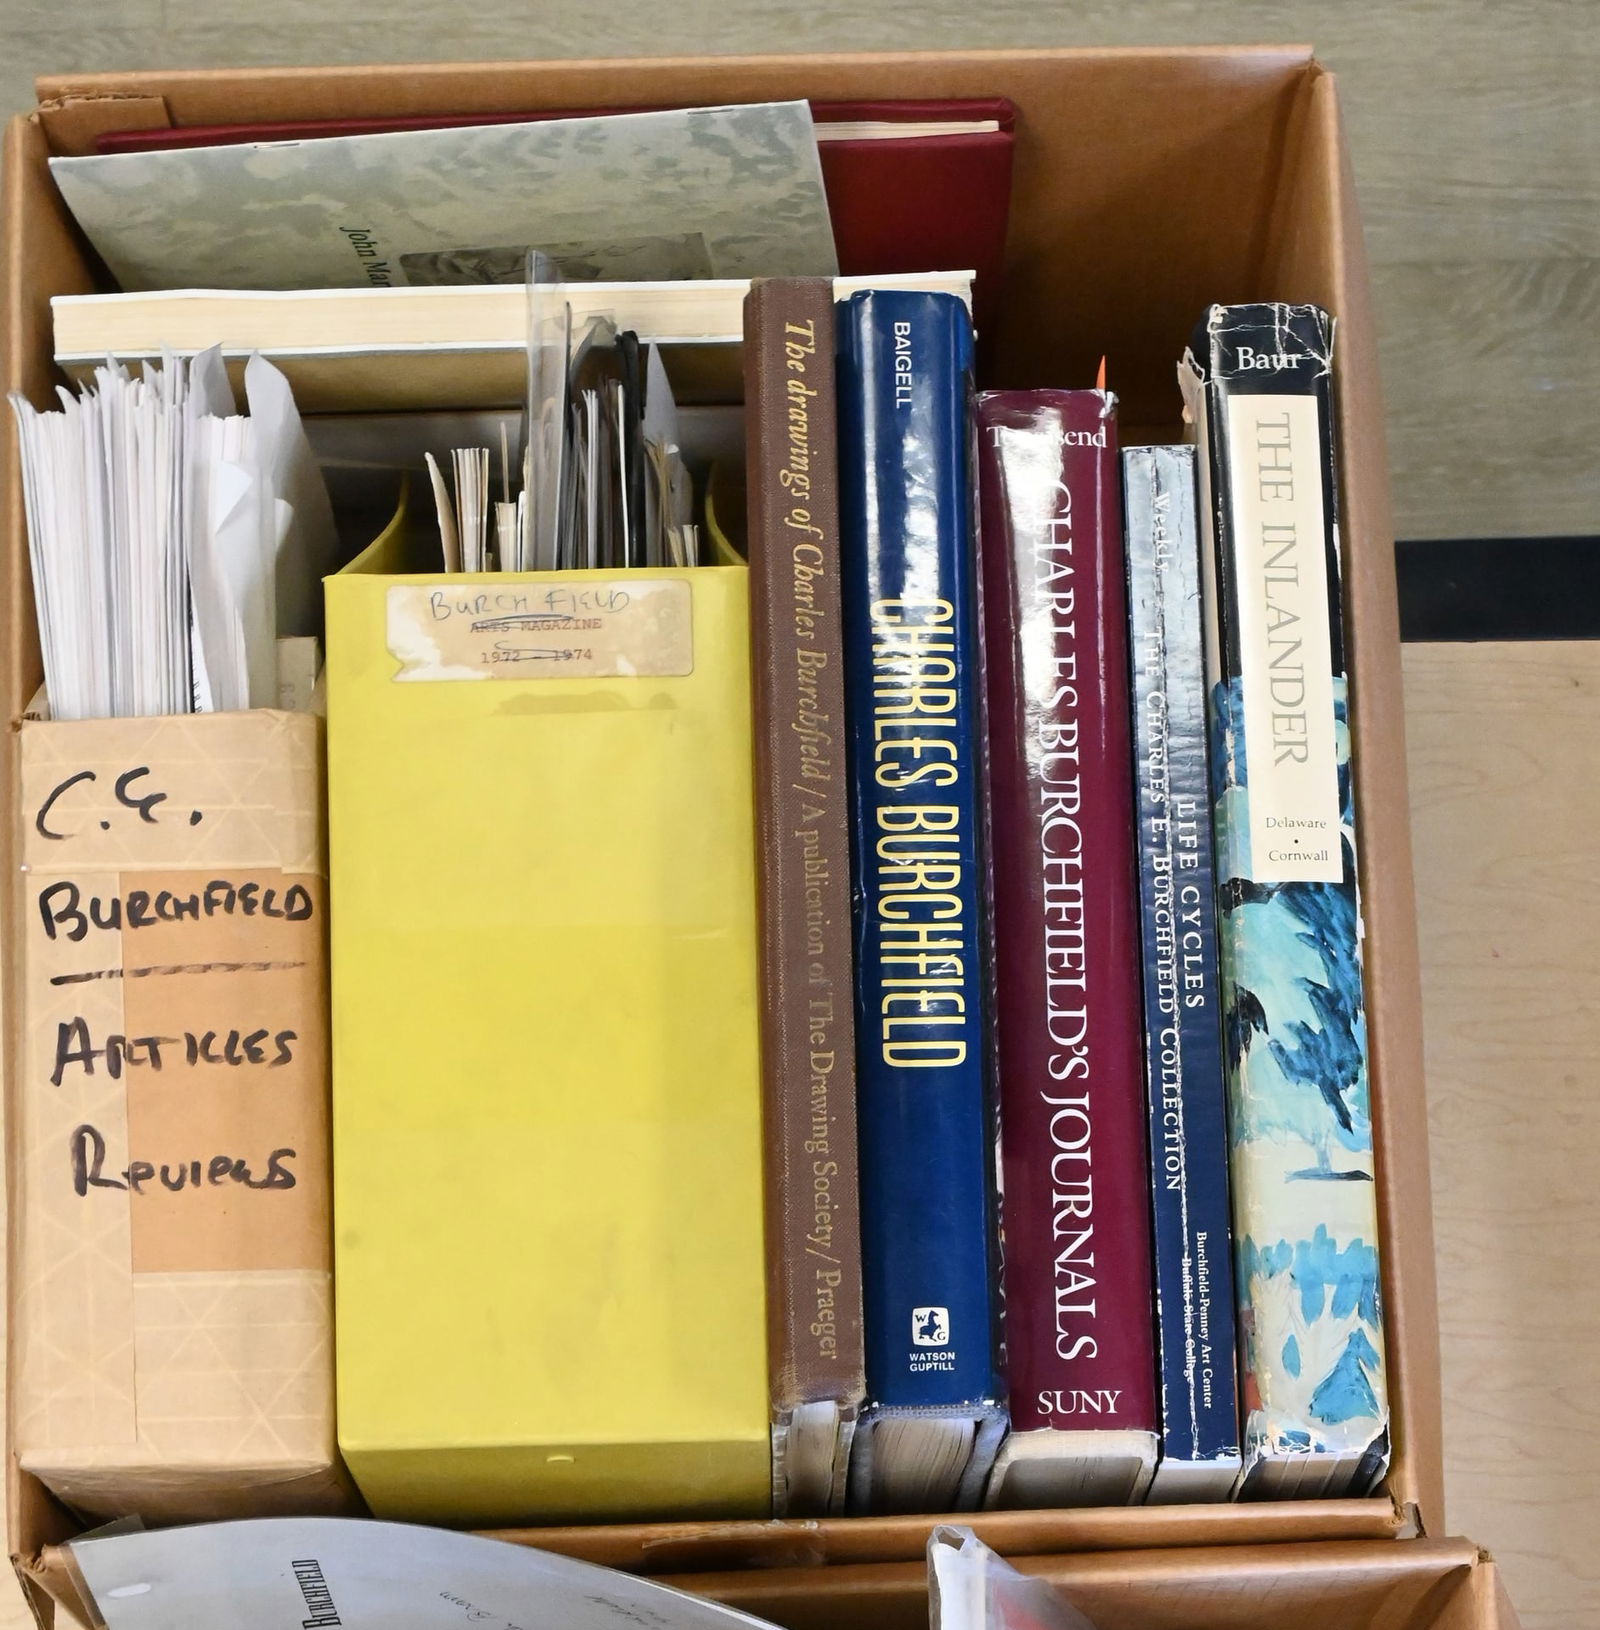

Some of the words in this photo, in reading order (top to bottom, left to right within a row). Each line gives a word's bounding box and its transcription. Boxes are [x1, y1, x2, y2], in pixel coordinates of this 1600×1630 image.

[339, 226, 378, 258] John
[785, 320, 816, 373] The
[893, 321, 912, 409] BAIGELL
[1235, 346, 1301, 370] Baur
[779, 378, 813, 503] drawings
[1255, 412, 1294, 504] THE
[784, 508, 825, 540] of
[791, 545, 825, 637] Charles
[1032, 481, 1078, 709] CHARLES
[1144, 624, 1162, 674] THE
[1261, 522, 1309, 768] INLANDER
[791, 649, 832, 780] Burchfield
[869, 598, 959, 788] CHARLES
[1144, 691, 1166, 804] CHARLES
[1176, 800, 1197, 869] LIFE
[1265, 816, 1327, 831] Delaware
[1268, 849, 1329, 863] Cornwall
[38, 880, 314, 942] BURCHFIELD
[794, 829, 832, 957] publication
[876, 805, 967, 1068] BURCHFIELD
[1037, 718, 1090, 1081] BURCHFIELD'S
[1152, 854, 1175, 1014] BURCHFIELD
[1180, 885, 1205, 1009] CYCLES
[50, 1016, 298, 1087] ARTICLES
[808, 991, 834, 1045] The
[805, 1051, 836, 1157] Drawing
[1159, 1027, 1182, 1191] COLLECTION
[1040, 1089, 1098, 1360] JOURNALS
[808, 1268, 842, 1360] Praeger
[1196, 1231, 1210, 1341] Burchfield-Penney
[909, 1351, 956, 1361] WATSON
[909, 1362, 955, 1372] GUPTILL
[1037, 1389, 1122, 1414] SUNY
[291, 1559, 342, 1630] BURCHFIELD
